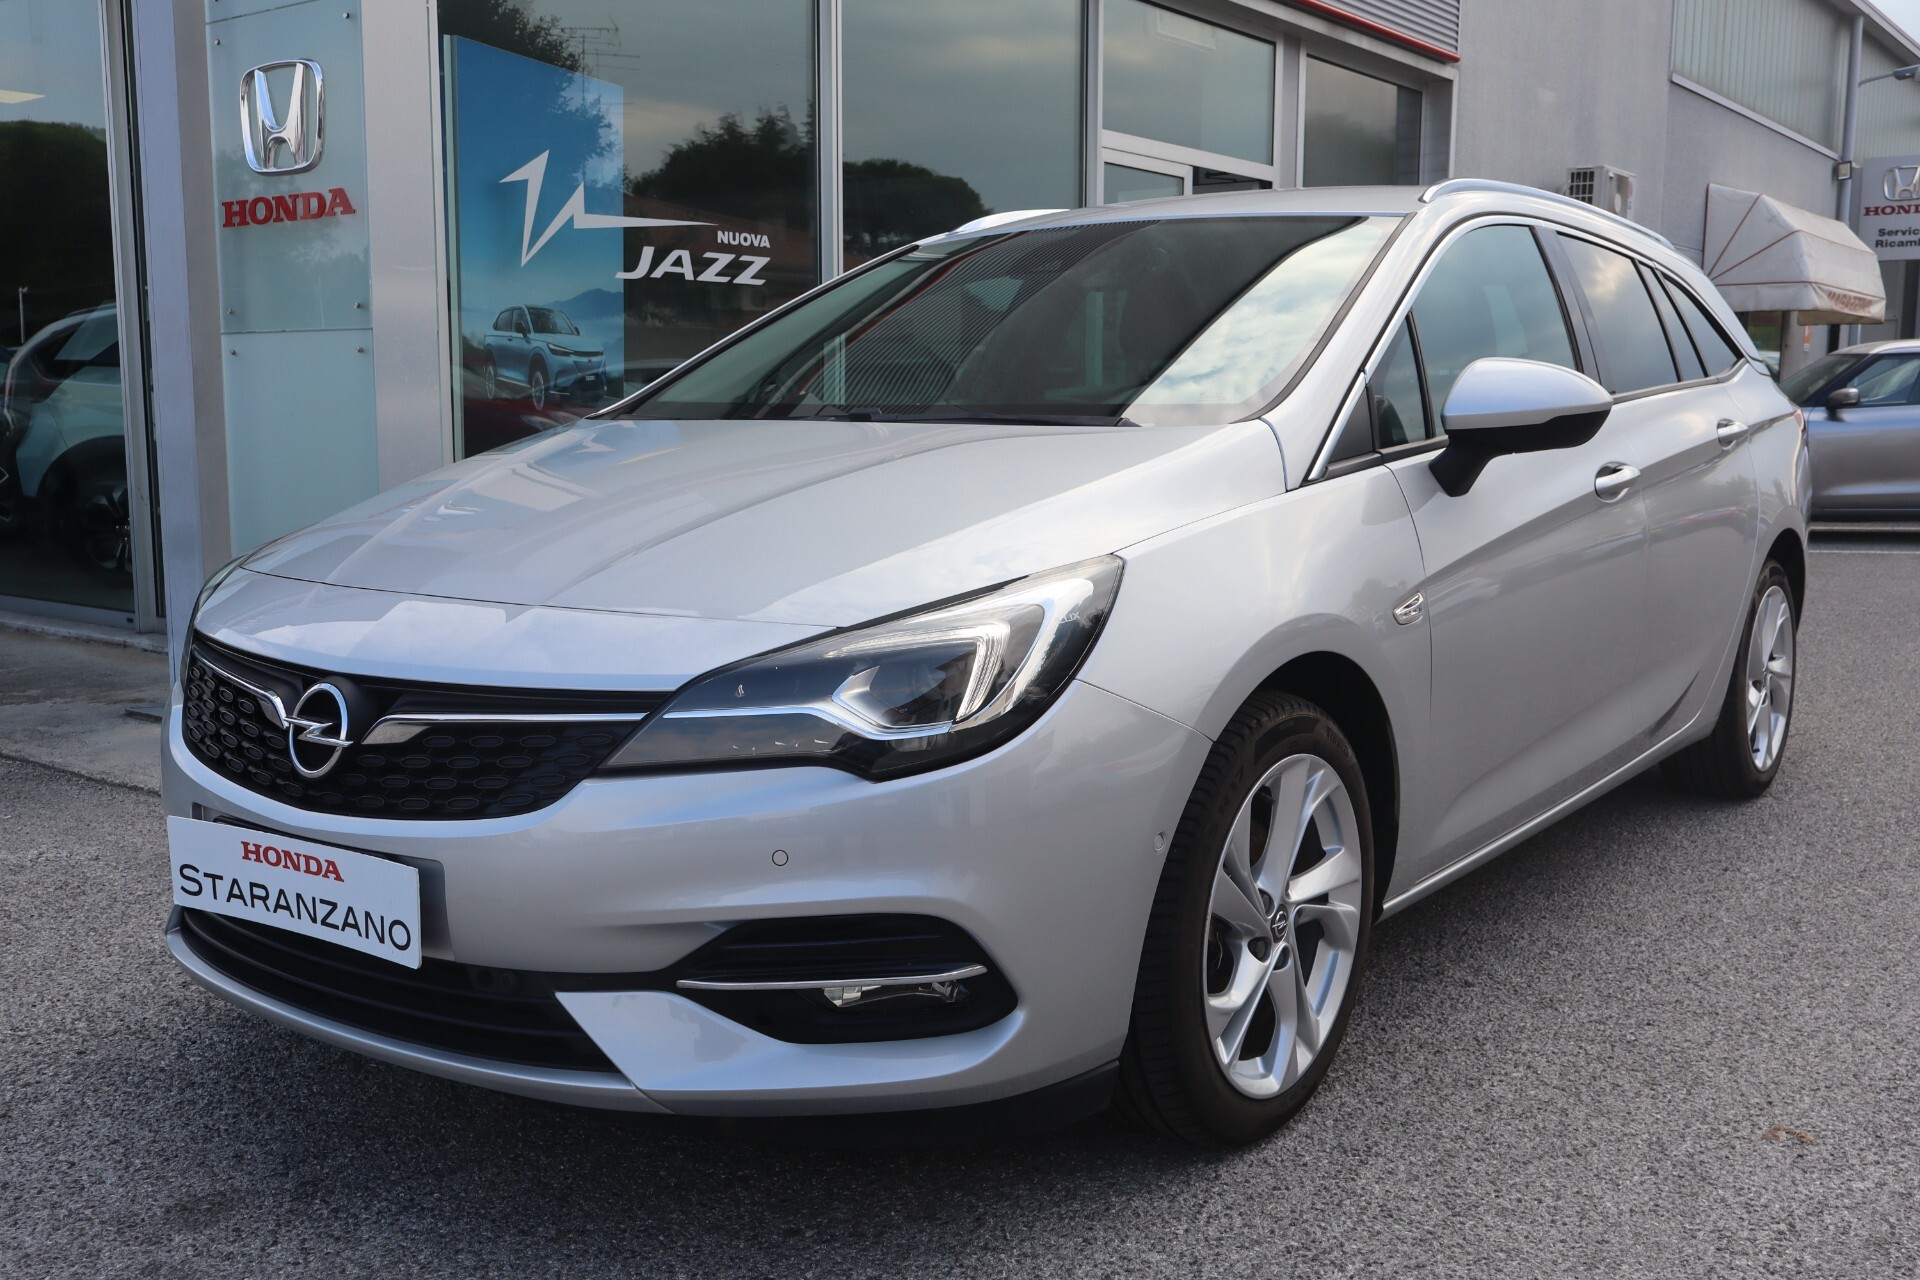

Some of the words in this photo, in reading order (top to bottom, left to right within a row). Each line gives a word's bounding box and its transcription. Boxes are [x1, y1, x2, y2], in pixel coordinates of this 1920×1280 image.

[222, 188, 356, 228] HONDA
[717, 230, 771, 248] NUOVA
[1878, 227, 1920, 237] Servic
[615, 246, 771, 286] JAZZ
[240, 841, 344, 882] HONDA
[179, 863, 411, 951] STARANZANO
